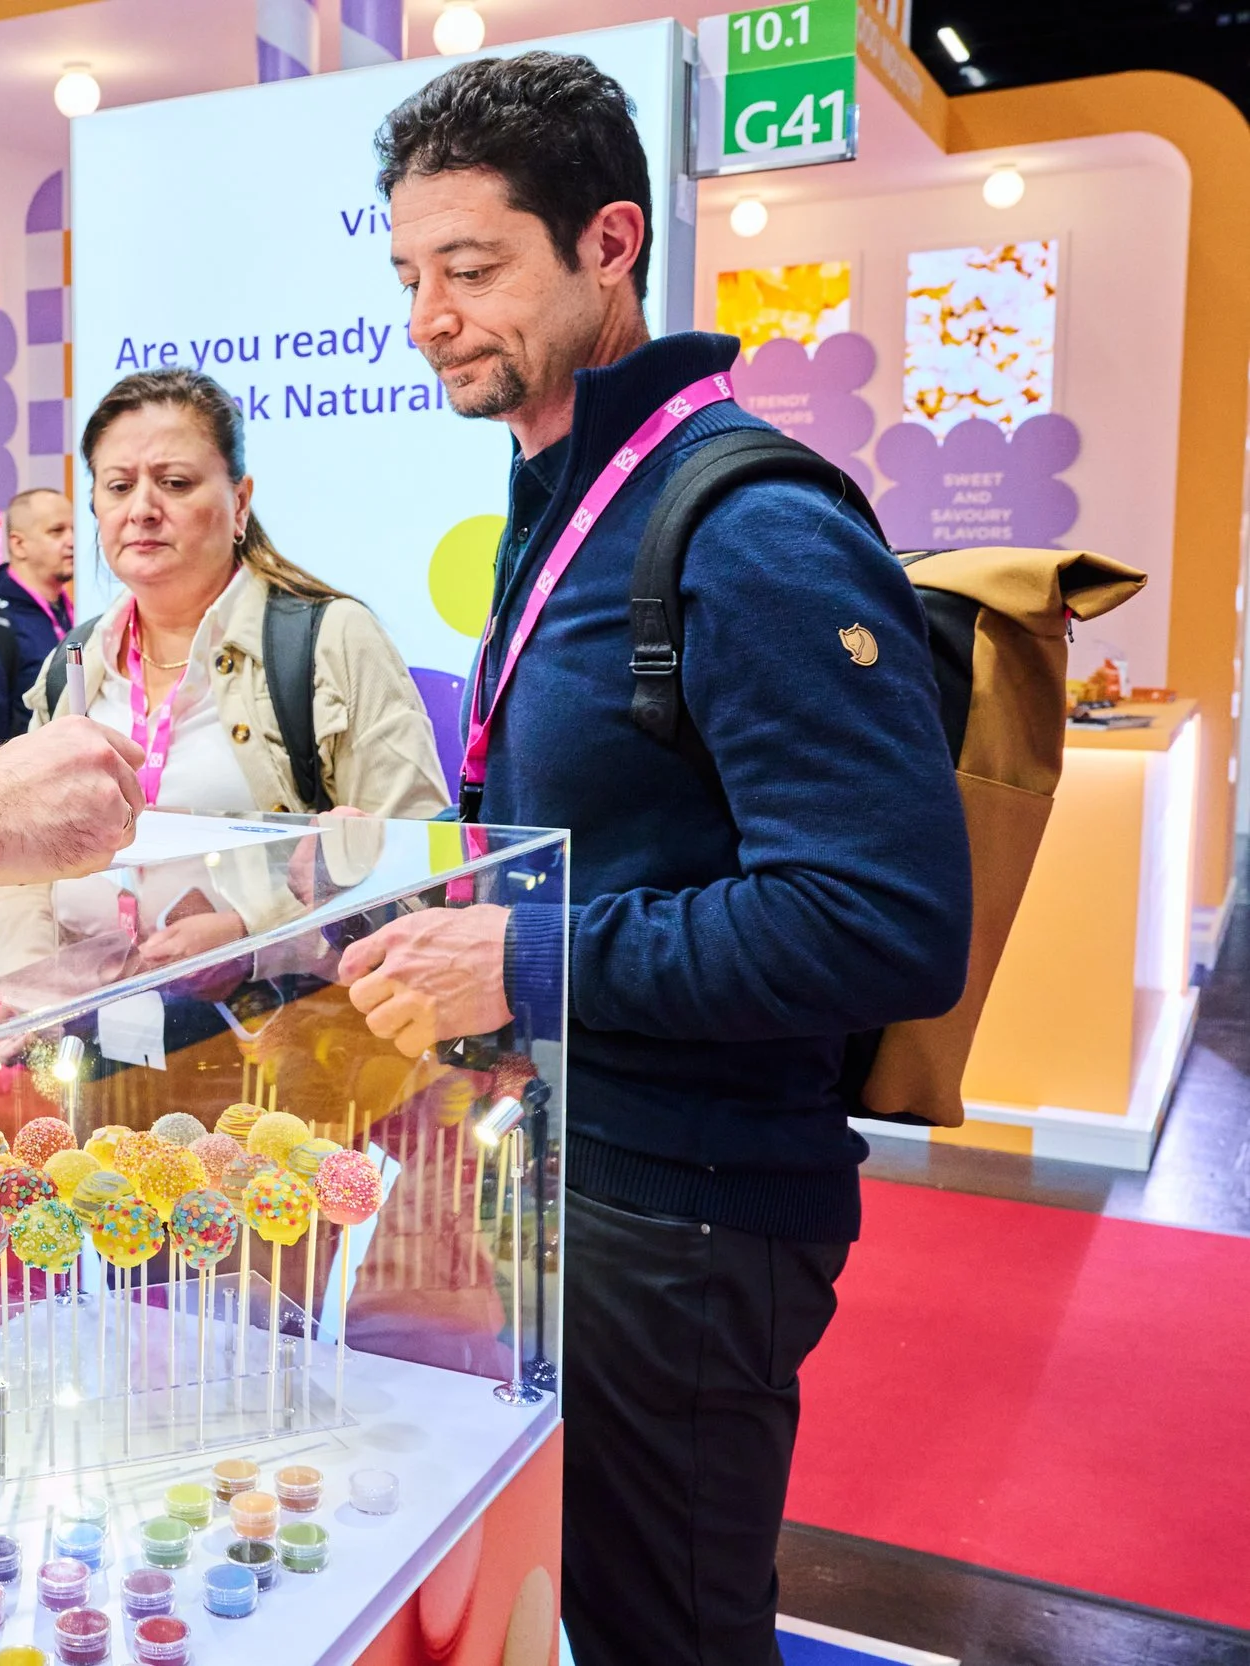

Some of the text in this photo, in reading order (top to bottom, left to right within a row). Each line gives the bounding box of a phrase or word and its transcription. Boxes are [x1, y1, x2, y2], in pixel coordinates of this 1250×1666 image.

[733, 5, 810, 54] 10.1
[734, 89, 845, 152] G41
[115, 337, 179, 370] Are
[190, 337, 260, 370] you
[275, 317, 391, 363] ready
[943, 471, 1004, 488] SWEET
[952, 490, 992, 505] AND
[931, 508, 1013, 523] SAVOURY
[932, 526, 1013, 541] FLAVORS
